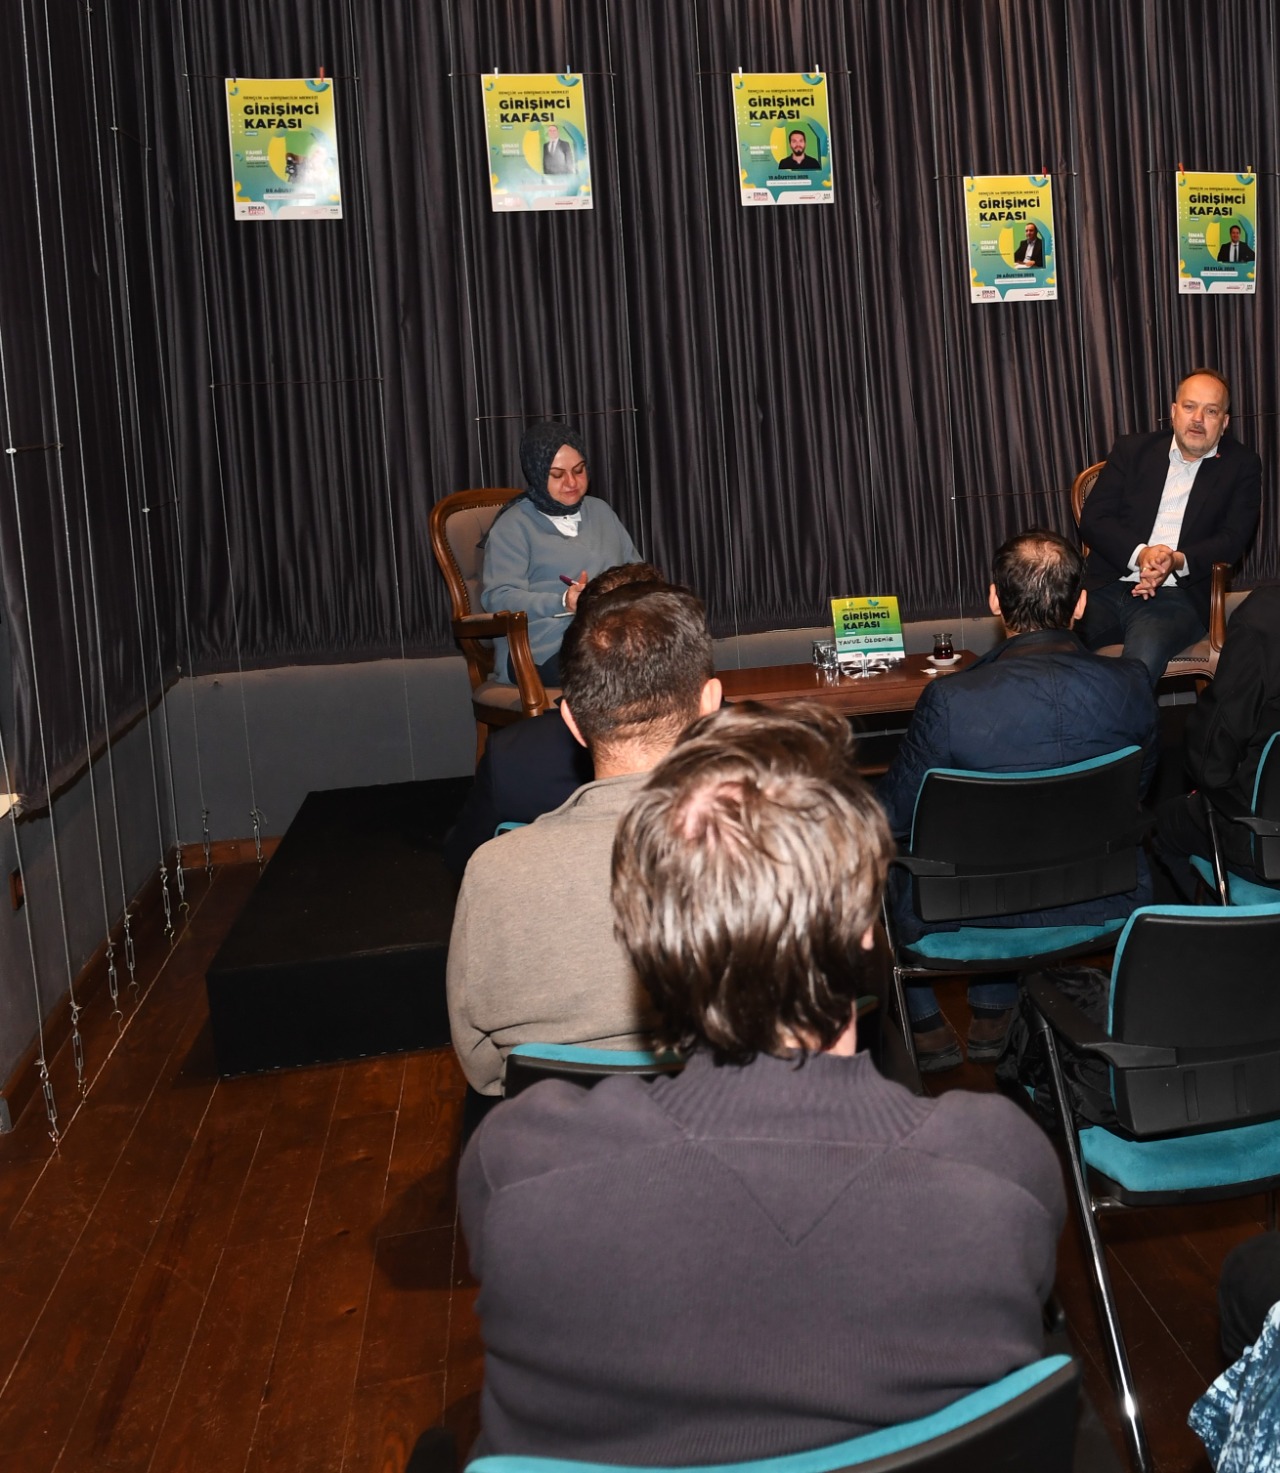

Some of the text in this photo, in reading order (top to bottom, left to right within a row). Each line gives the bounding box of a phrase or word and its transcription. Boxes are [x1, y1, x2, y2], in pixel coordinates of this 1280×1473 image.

[499, 96, 570, 110] GİRİŞİMCİ
[748, 95, 815, 108] GİRİŞİMCİ
[243, 102, 319, 117] GİRİŞİMCİ
[749, 110, 800, 120] KAFASI
[500, 112, 554, 123] KAFASI
[244, 118, 302, 129] KAFASI
[979, 196, 1040, 210] GİRİŞİMCİ
[1189, 192, 1246, 205] GİRİŞİMCİ
[979, 211, 1026, 221] KAFASI
[1189, 206, 1232, 216] KAFASI
[842, 610, 890, 621] GİRİŞİMCİ
[844, 621, 880, 630] KAFASI
[838, 638, 861, 646] YAVUZ
